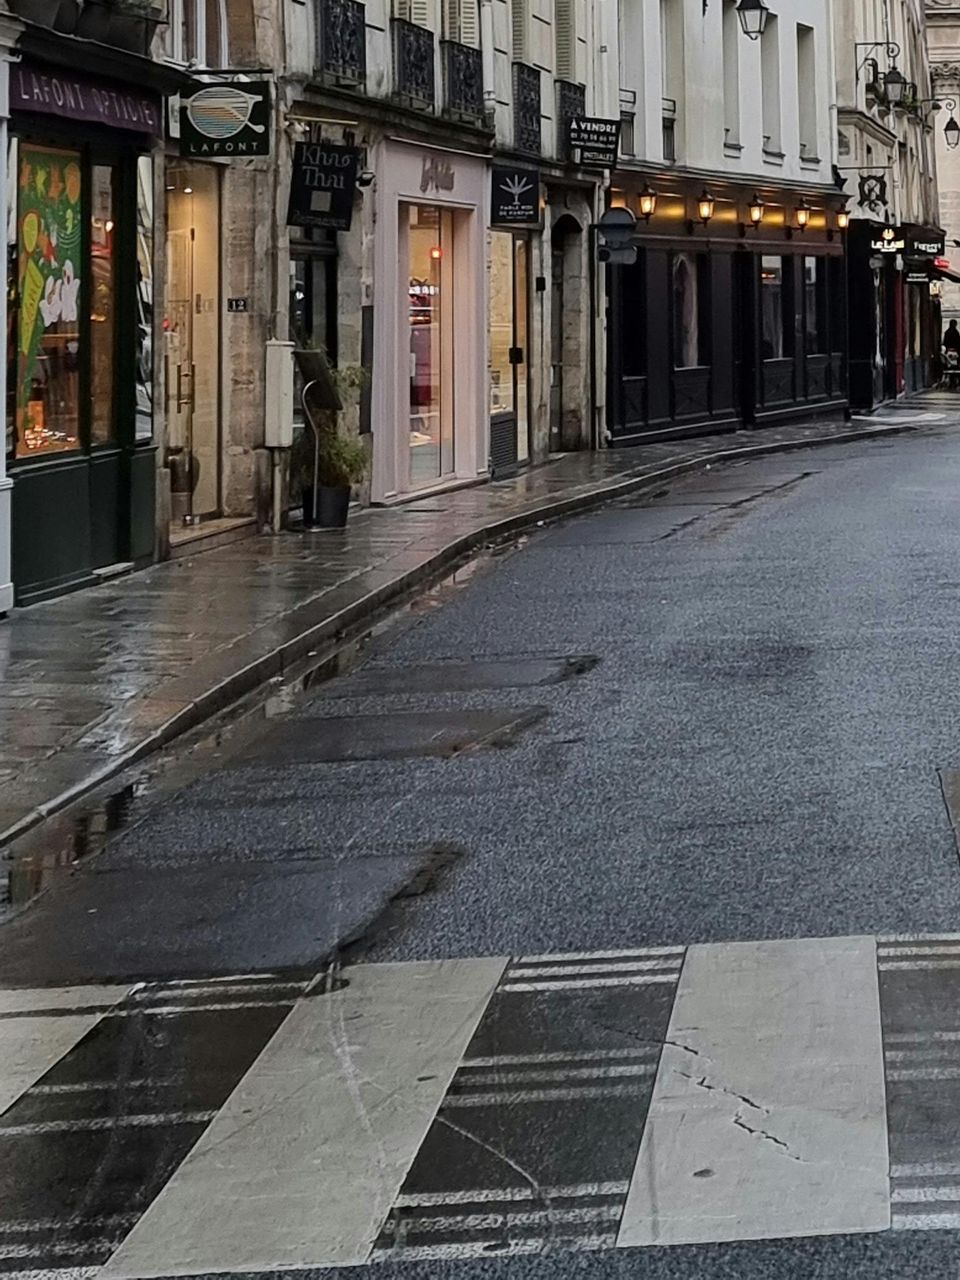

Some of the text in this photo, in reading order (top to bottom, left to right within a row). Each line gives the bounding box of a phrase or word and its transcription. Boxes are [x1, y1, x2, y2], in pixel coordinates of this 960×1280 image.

[18, 71, 85, 110] LAFONT
[580, 121, 616, 133] VENDRE
[190, 142, 258, 152] LAFONT
[231, 300, 245, 311] 12
